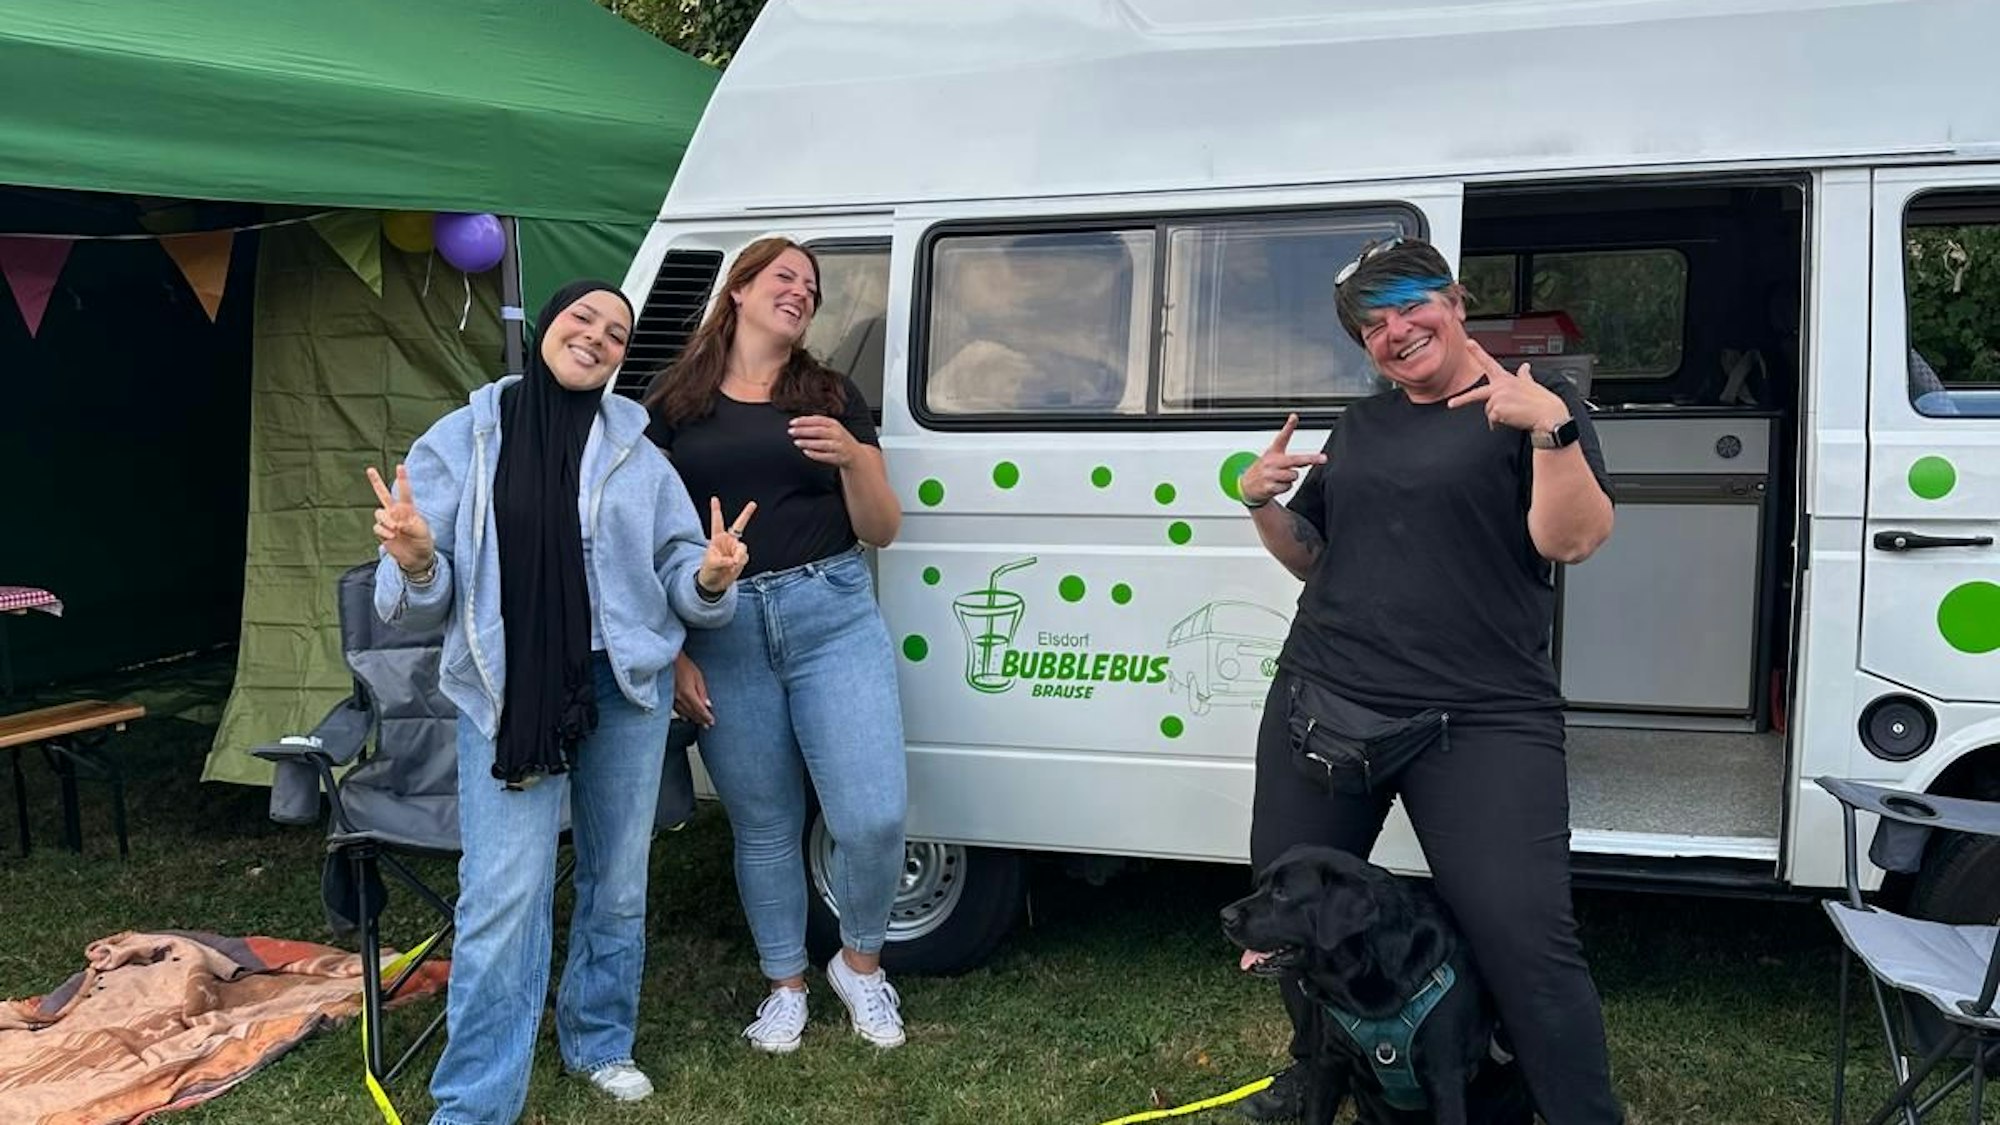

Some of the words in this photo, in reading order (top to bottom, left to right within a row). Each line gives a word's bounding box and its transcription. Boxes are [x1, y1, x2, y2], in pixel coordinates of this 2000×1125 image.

[1038, 631, 1090, 647] Elsdorf
[1002, 650, 1169, 684] BUBBLEBUS
[1032, 684, 1094, 699] BRAUSE
